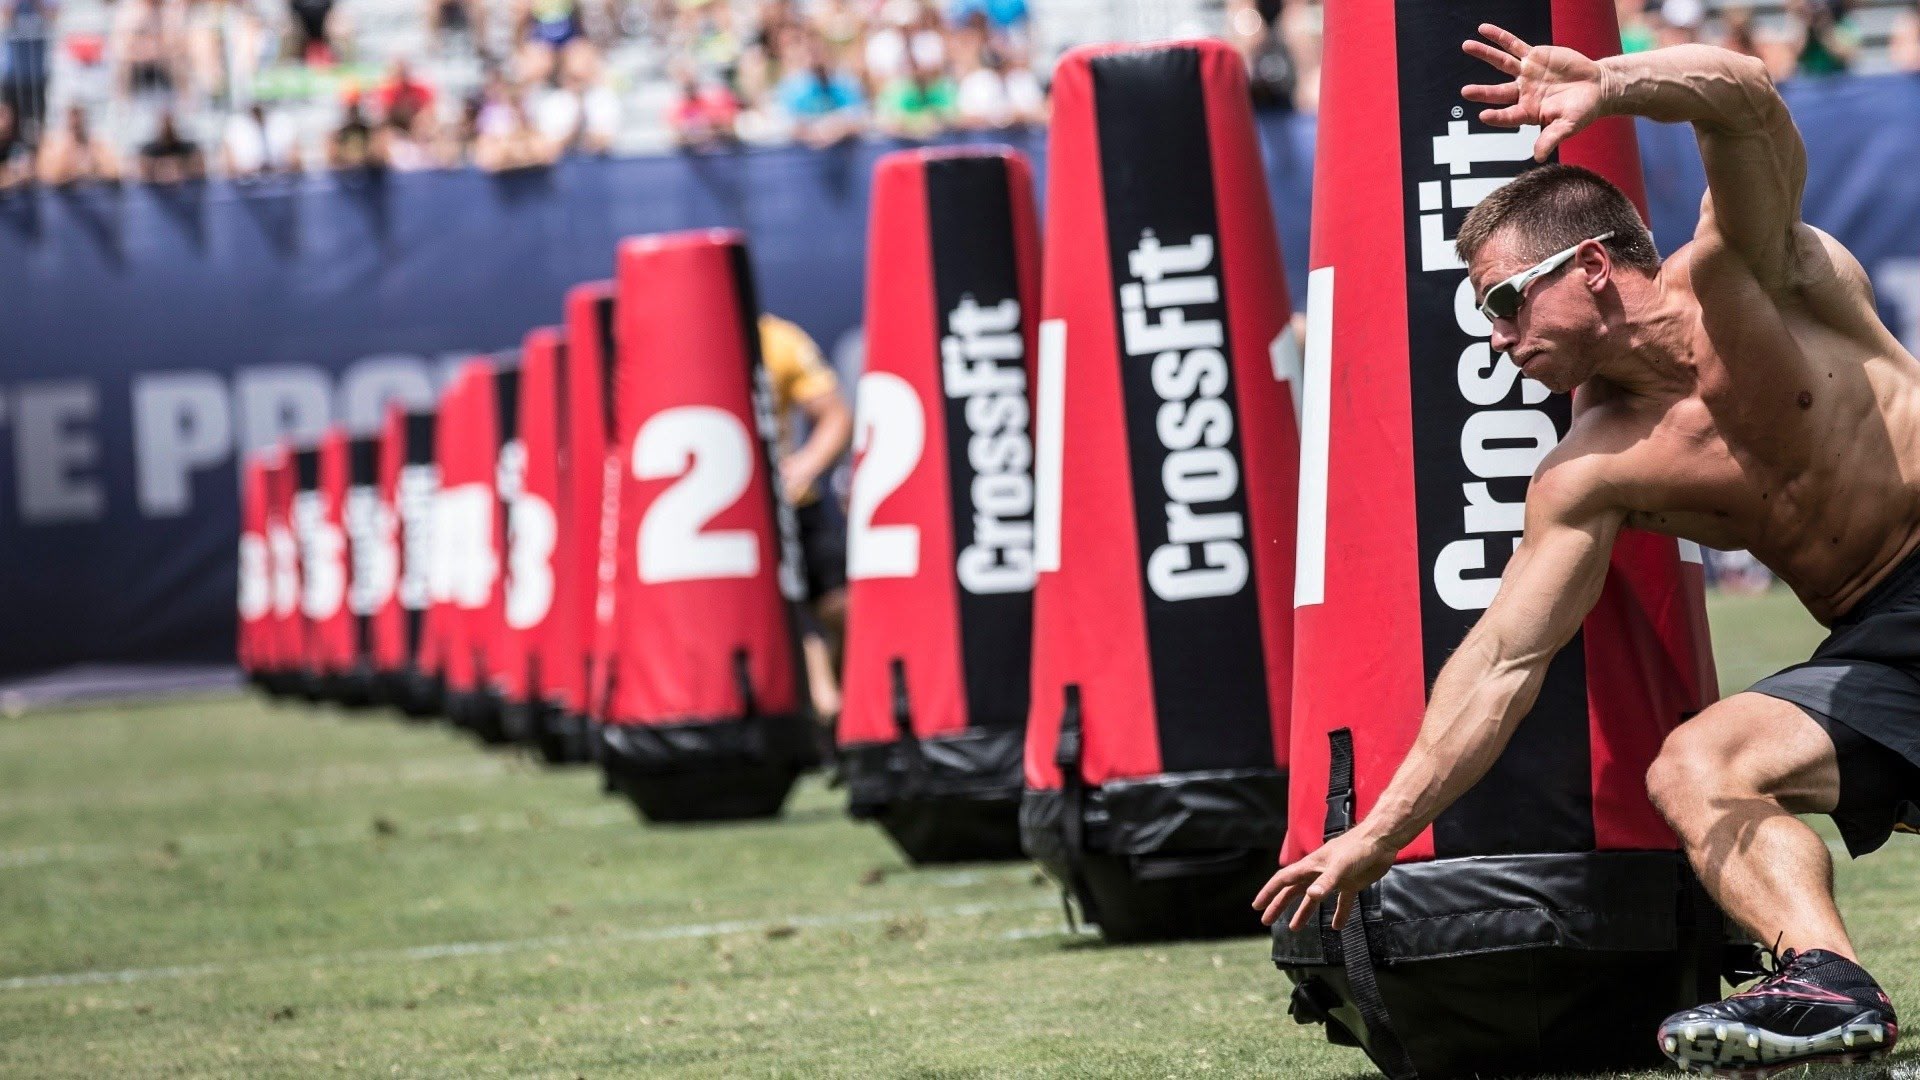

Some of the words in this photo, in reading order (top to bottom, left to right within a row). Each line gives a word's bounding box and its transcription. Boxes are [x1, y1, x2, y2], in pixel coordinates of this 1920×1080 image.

[631, 405, 760, 584] 2
[846, 371, 926, 580] 2
[941, 298, 1039, 595] CrossFit
[1120, 233, 1249, 601] CrossFit
